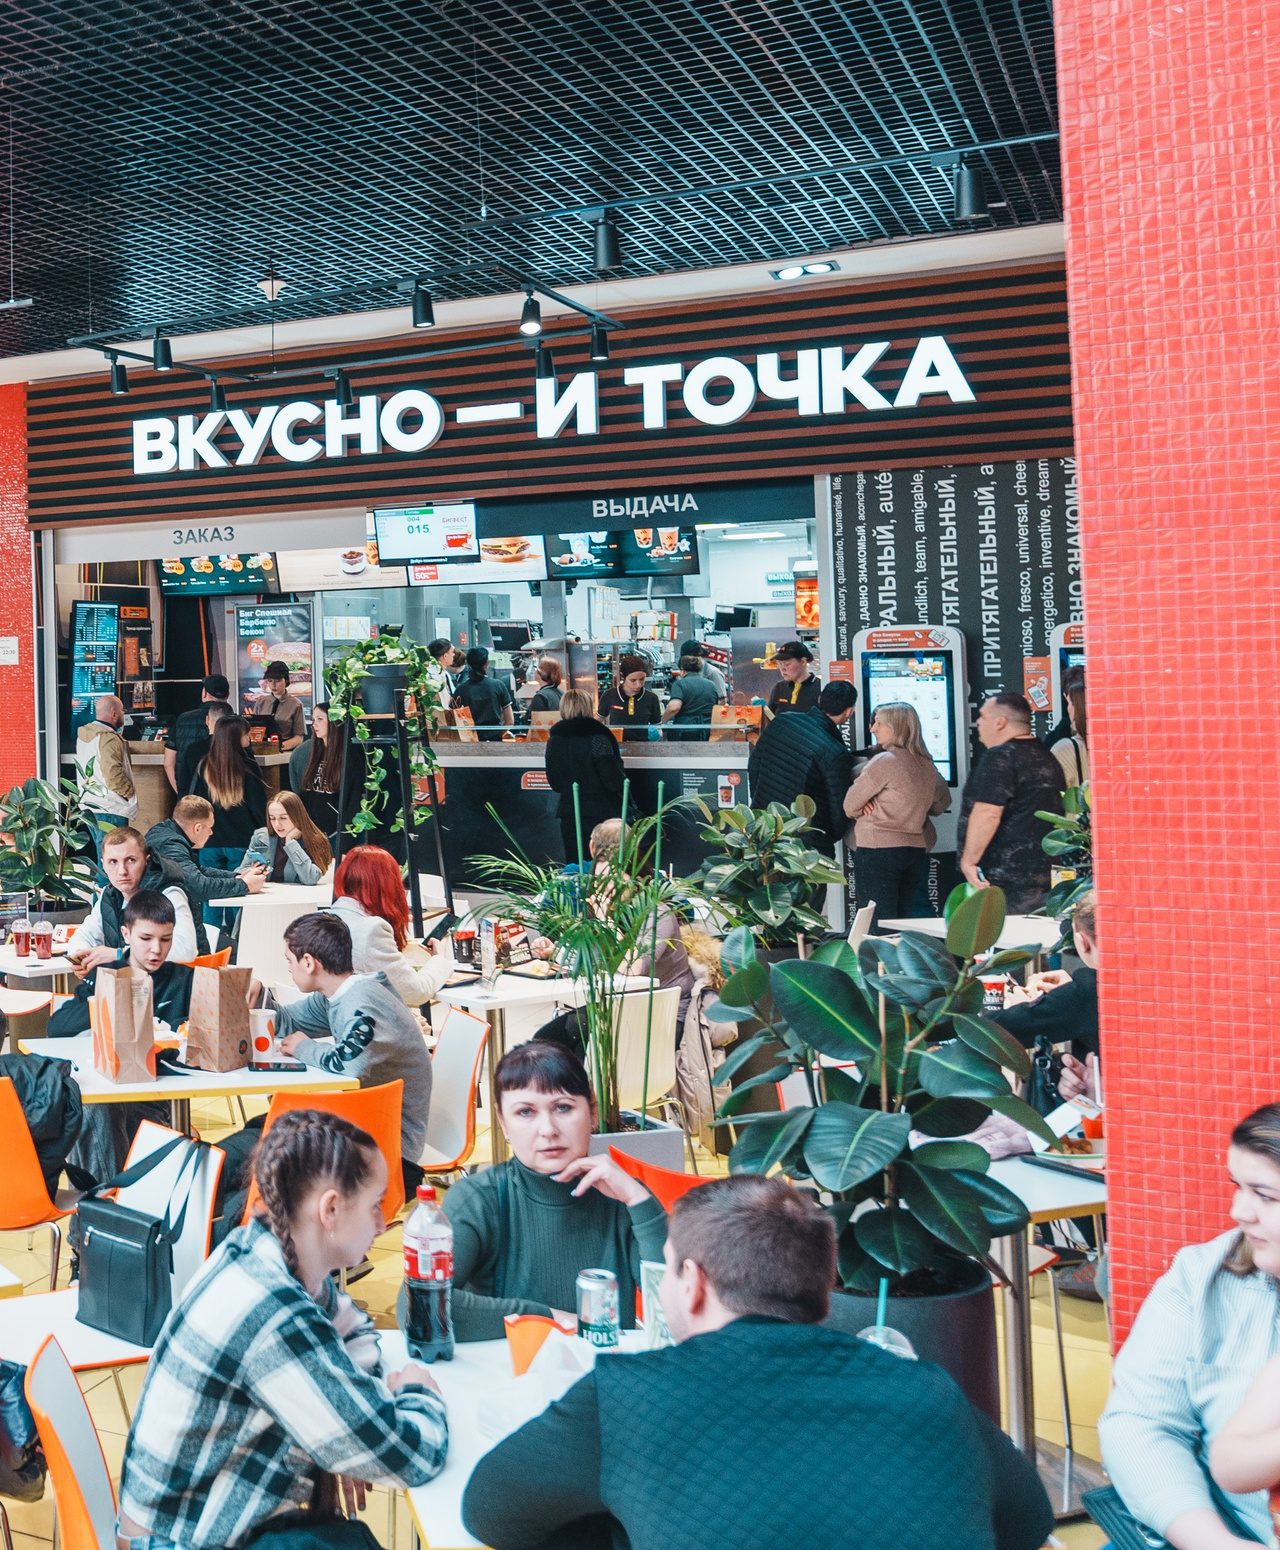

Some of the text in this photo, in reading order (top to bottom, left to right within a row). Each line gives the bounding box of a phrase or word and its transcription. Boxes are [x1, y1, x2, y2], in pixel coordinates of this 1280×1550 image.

[133, 389, 444, 474] ВКУСНО
[536, 372, 600, 440] И
[624, 336, 976, 430] ТОЧКА
[592, 492, 699, 519] ВЫДАЧА
[911, 469, 927, 532] amigable,
[173, 526, 235, 546] ЗАКАЗ
[407, 524, 430, 534] 015
[1014, 500, 1030, 563] universal,
[1037, 505, 1054, 568] inventive,
[834, 475, 847, 656] natural, savoury, qualitativo, humanisé, life,
[855, 522, 868, 583] ЗНАКОМЫЙ,
[914, 536, 927, 573] team,
[974, 481, 1002, 677] ПРИТЯГАТЕЛЬНЫЙ,
[1016, 567, 1032, 612] fresco,
[240, 618, 276, 627] Барбекю
[859, 585, 870, 620] ДАВНО
[240, 628, 264, 636] Бекон
